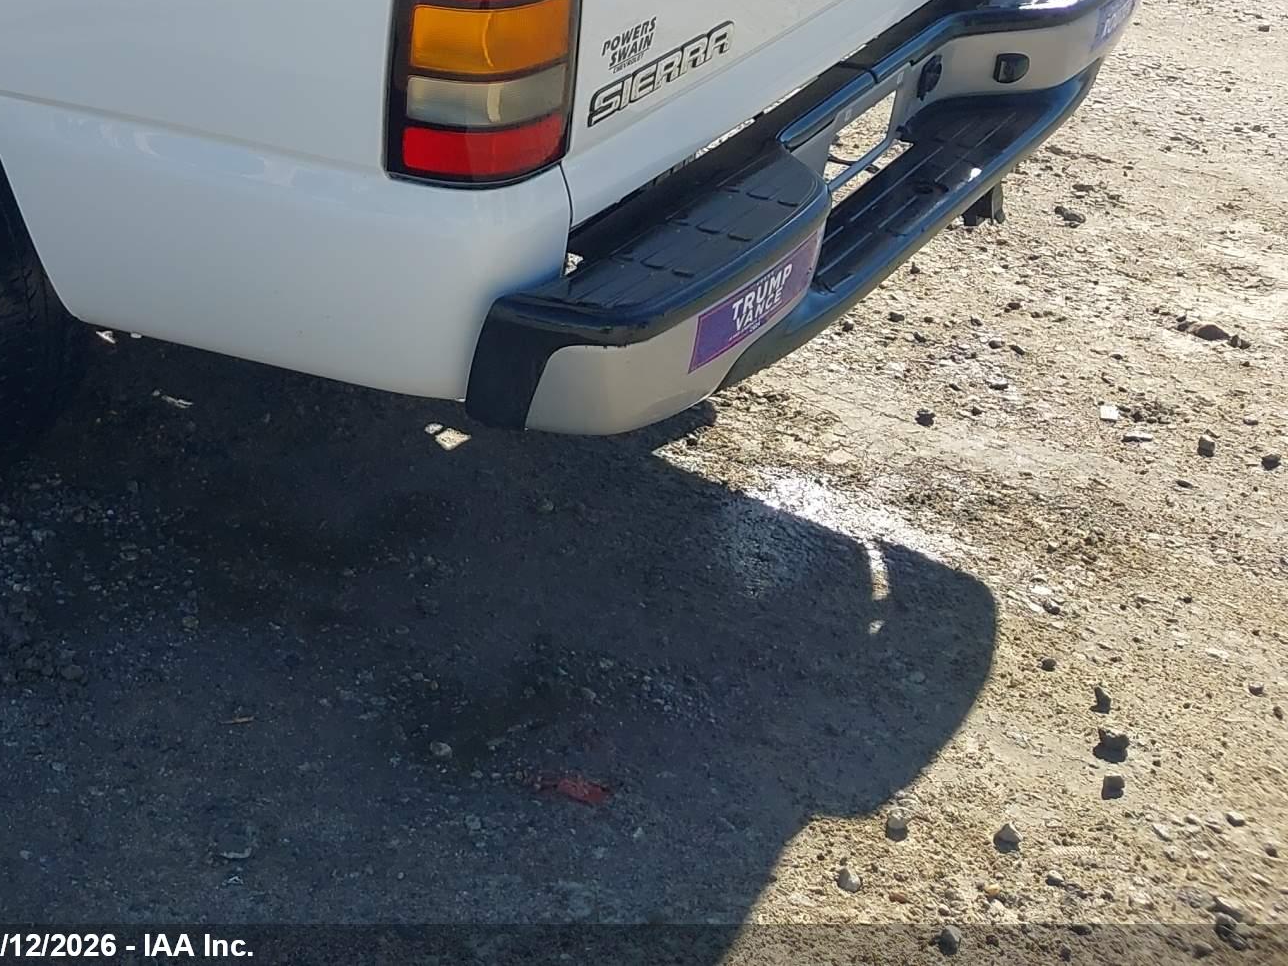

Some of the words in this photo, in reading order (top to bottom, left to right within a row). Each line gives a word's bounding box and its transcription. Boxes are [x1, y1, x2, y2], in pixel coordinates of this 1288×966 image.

[601, 16, 657, 56] POWERS
[609, 32, 654, 67] SWAIN
[587, 20, 736, 128] SIERRA
[732, 263, 793, 321] TRUMP
[736, 286, 783, 331] VANCE
